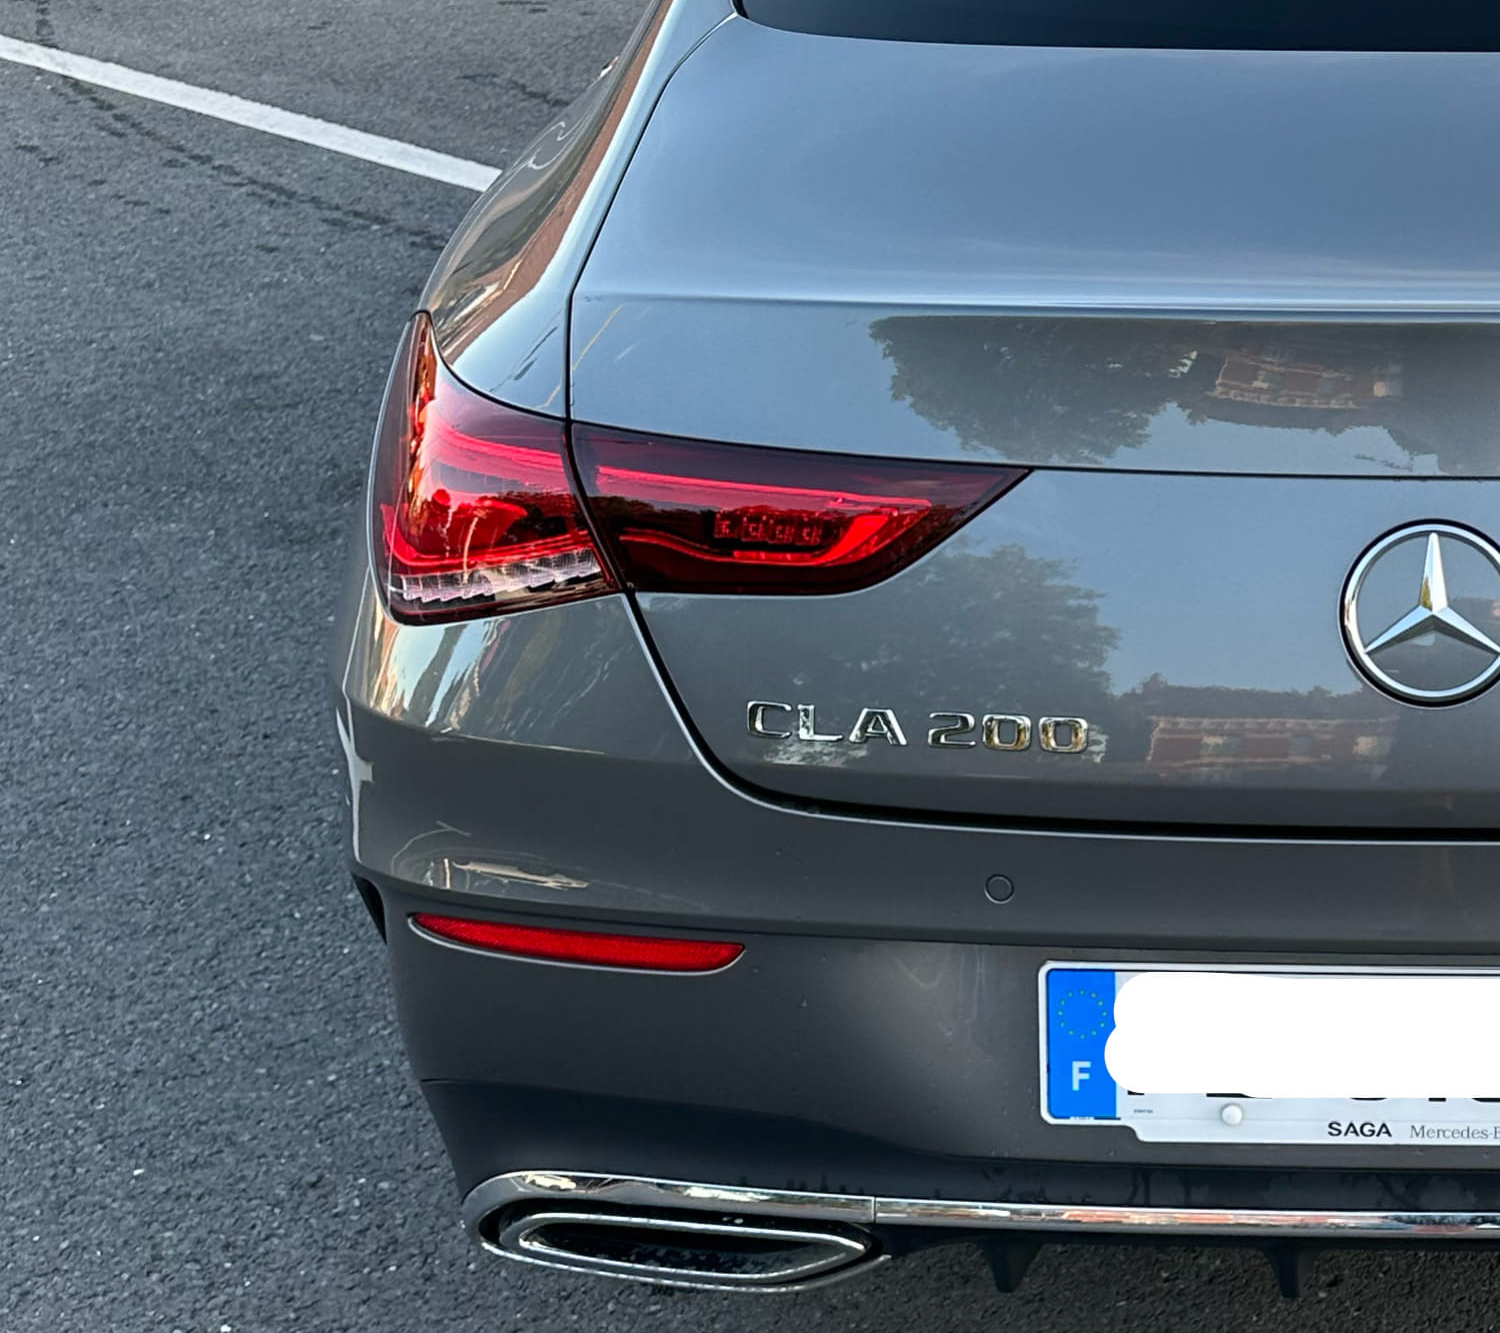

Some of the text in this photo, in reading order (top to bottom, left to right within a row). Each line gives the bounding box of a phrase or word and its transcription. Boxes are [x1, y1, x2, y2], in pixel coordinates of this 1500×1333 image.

[746, 700, 1089, 753] CLA 200
[1072, 1061, 1092, 1091] F
[1327, 1121, 1392, 1138] SAGA
